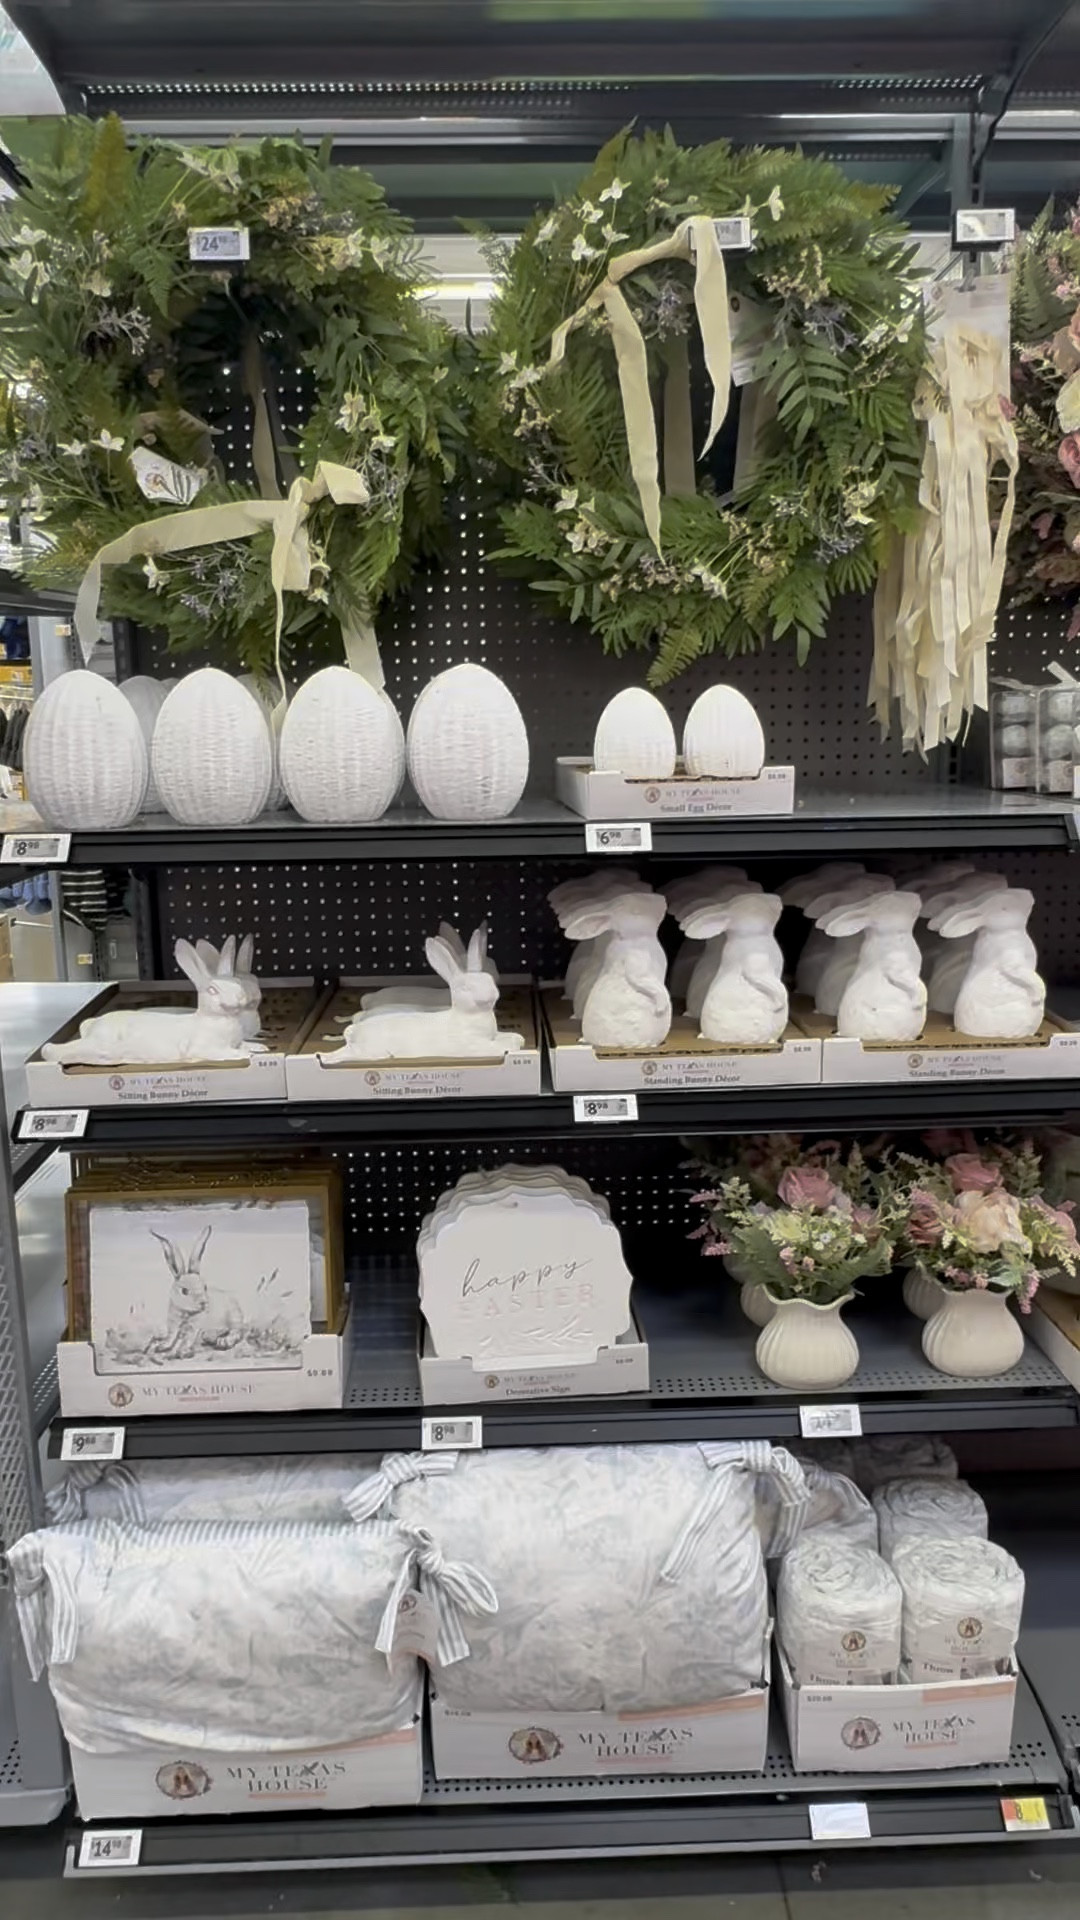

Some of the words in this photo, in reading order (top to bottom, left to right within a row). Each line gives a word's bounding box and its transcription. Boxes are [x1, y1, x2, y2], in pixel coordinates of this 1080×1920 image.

[660, 803, 686, 813] Small
[687, 803, 705, 813] Egg
[643, 1076, 683, 1085] Standing
[118, 1091, 148, 1101] Sitting
[149, 1091, 180, 1101] Bunny
[373, 1086, 403, 1096] Sitting
[404, 1086, 434, 1096] Bunny
[462, 1257, 594, 1298] happy
[456, 1283, 594, 1321] EASTER
[142, 1388, 159, 1397] MY
[166, 1384, 207, 1397] TEXAS
[210, 1383, 256, 1395] HOUSE
[551, 1385, 571, 1395] Sign
[892, 1721, 914, 1732] MY
[923, 1714, 977, 1731] TEXAS
[578, 1733, 607, 1745] MY
[621, 1727, 693, 1743] TEXAS
[904, 1730, 958, 1744] HOUSE
[597, 1743, 675, 1757] HOUSE
[226, 1766, 257, 1779] MY
[270, 1761, 347, 1778] TEXAS
[248, 1777, 329, 1793] HOUSE
